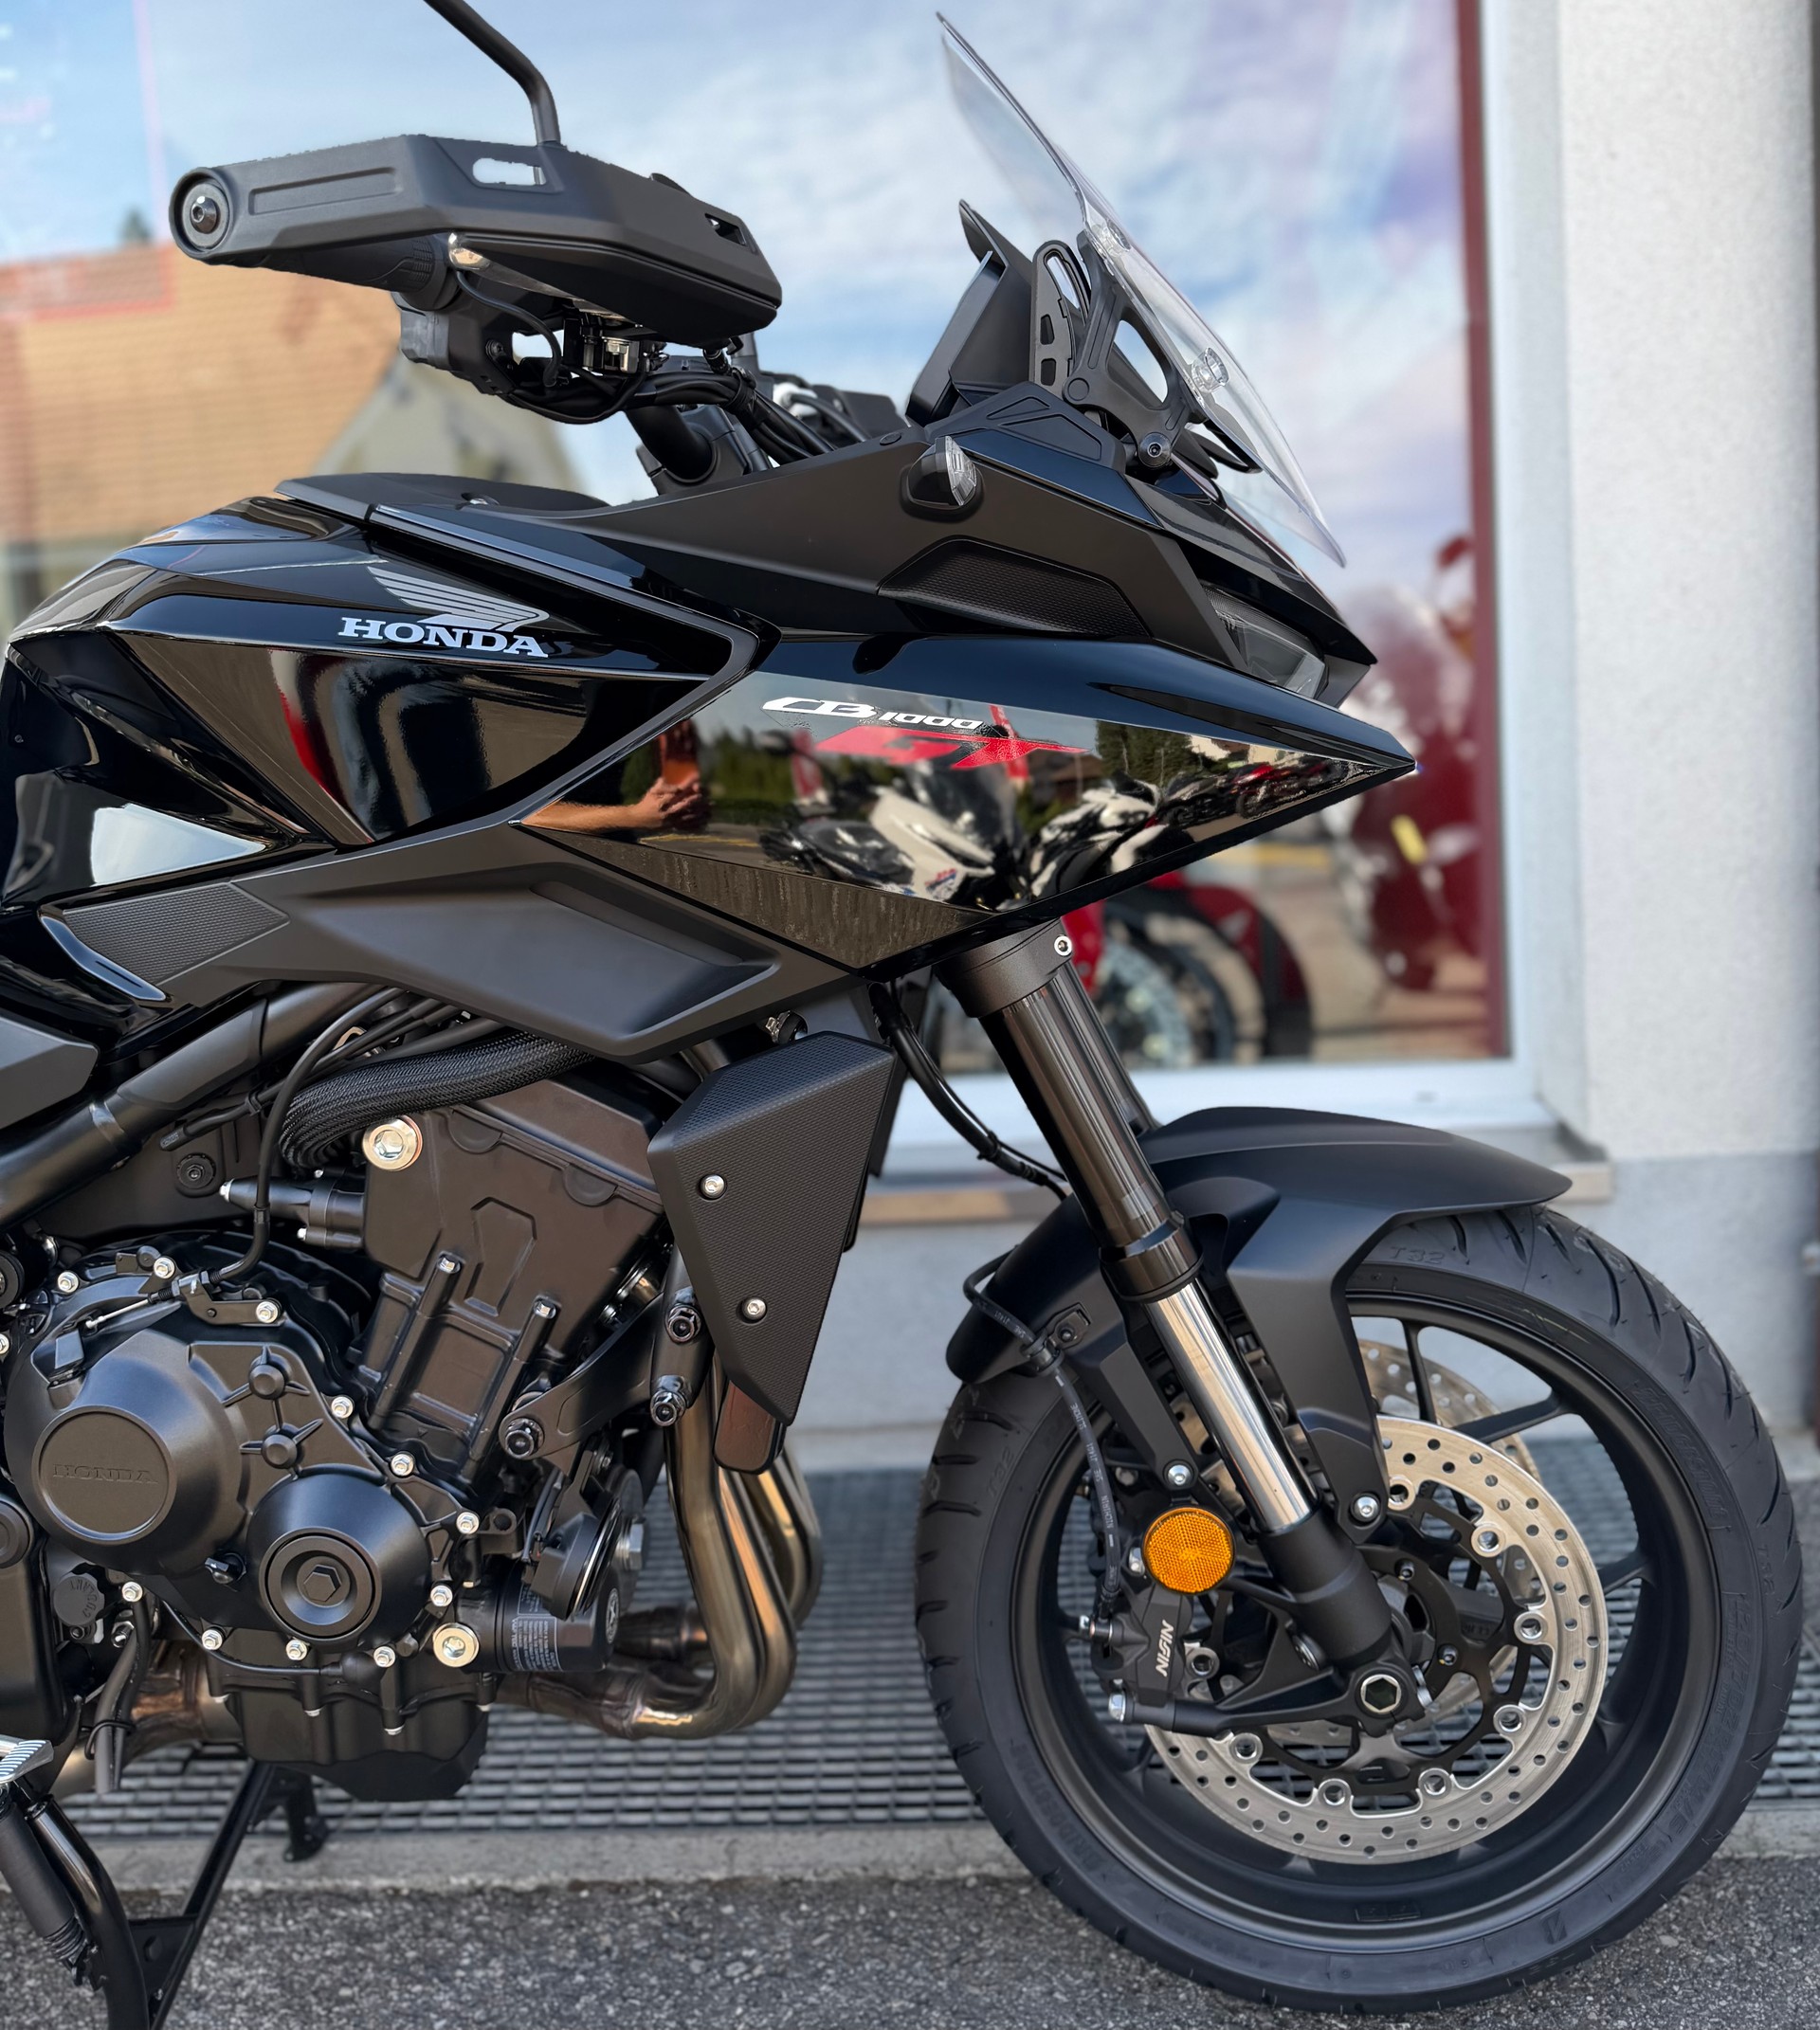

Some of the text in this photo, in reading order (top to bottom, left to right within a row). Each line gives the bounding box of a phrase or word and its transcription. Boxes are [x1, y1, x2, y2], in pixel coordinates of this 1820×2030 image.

[338, 617, 549, 658] HONDA
[1390, 1245, 1446, 1265] T32
[53, 1463, 159, 1484] HONDA
